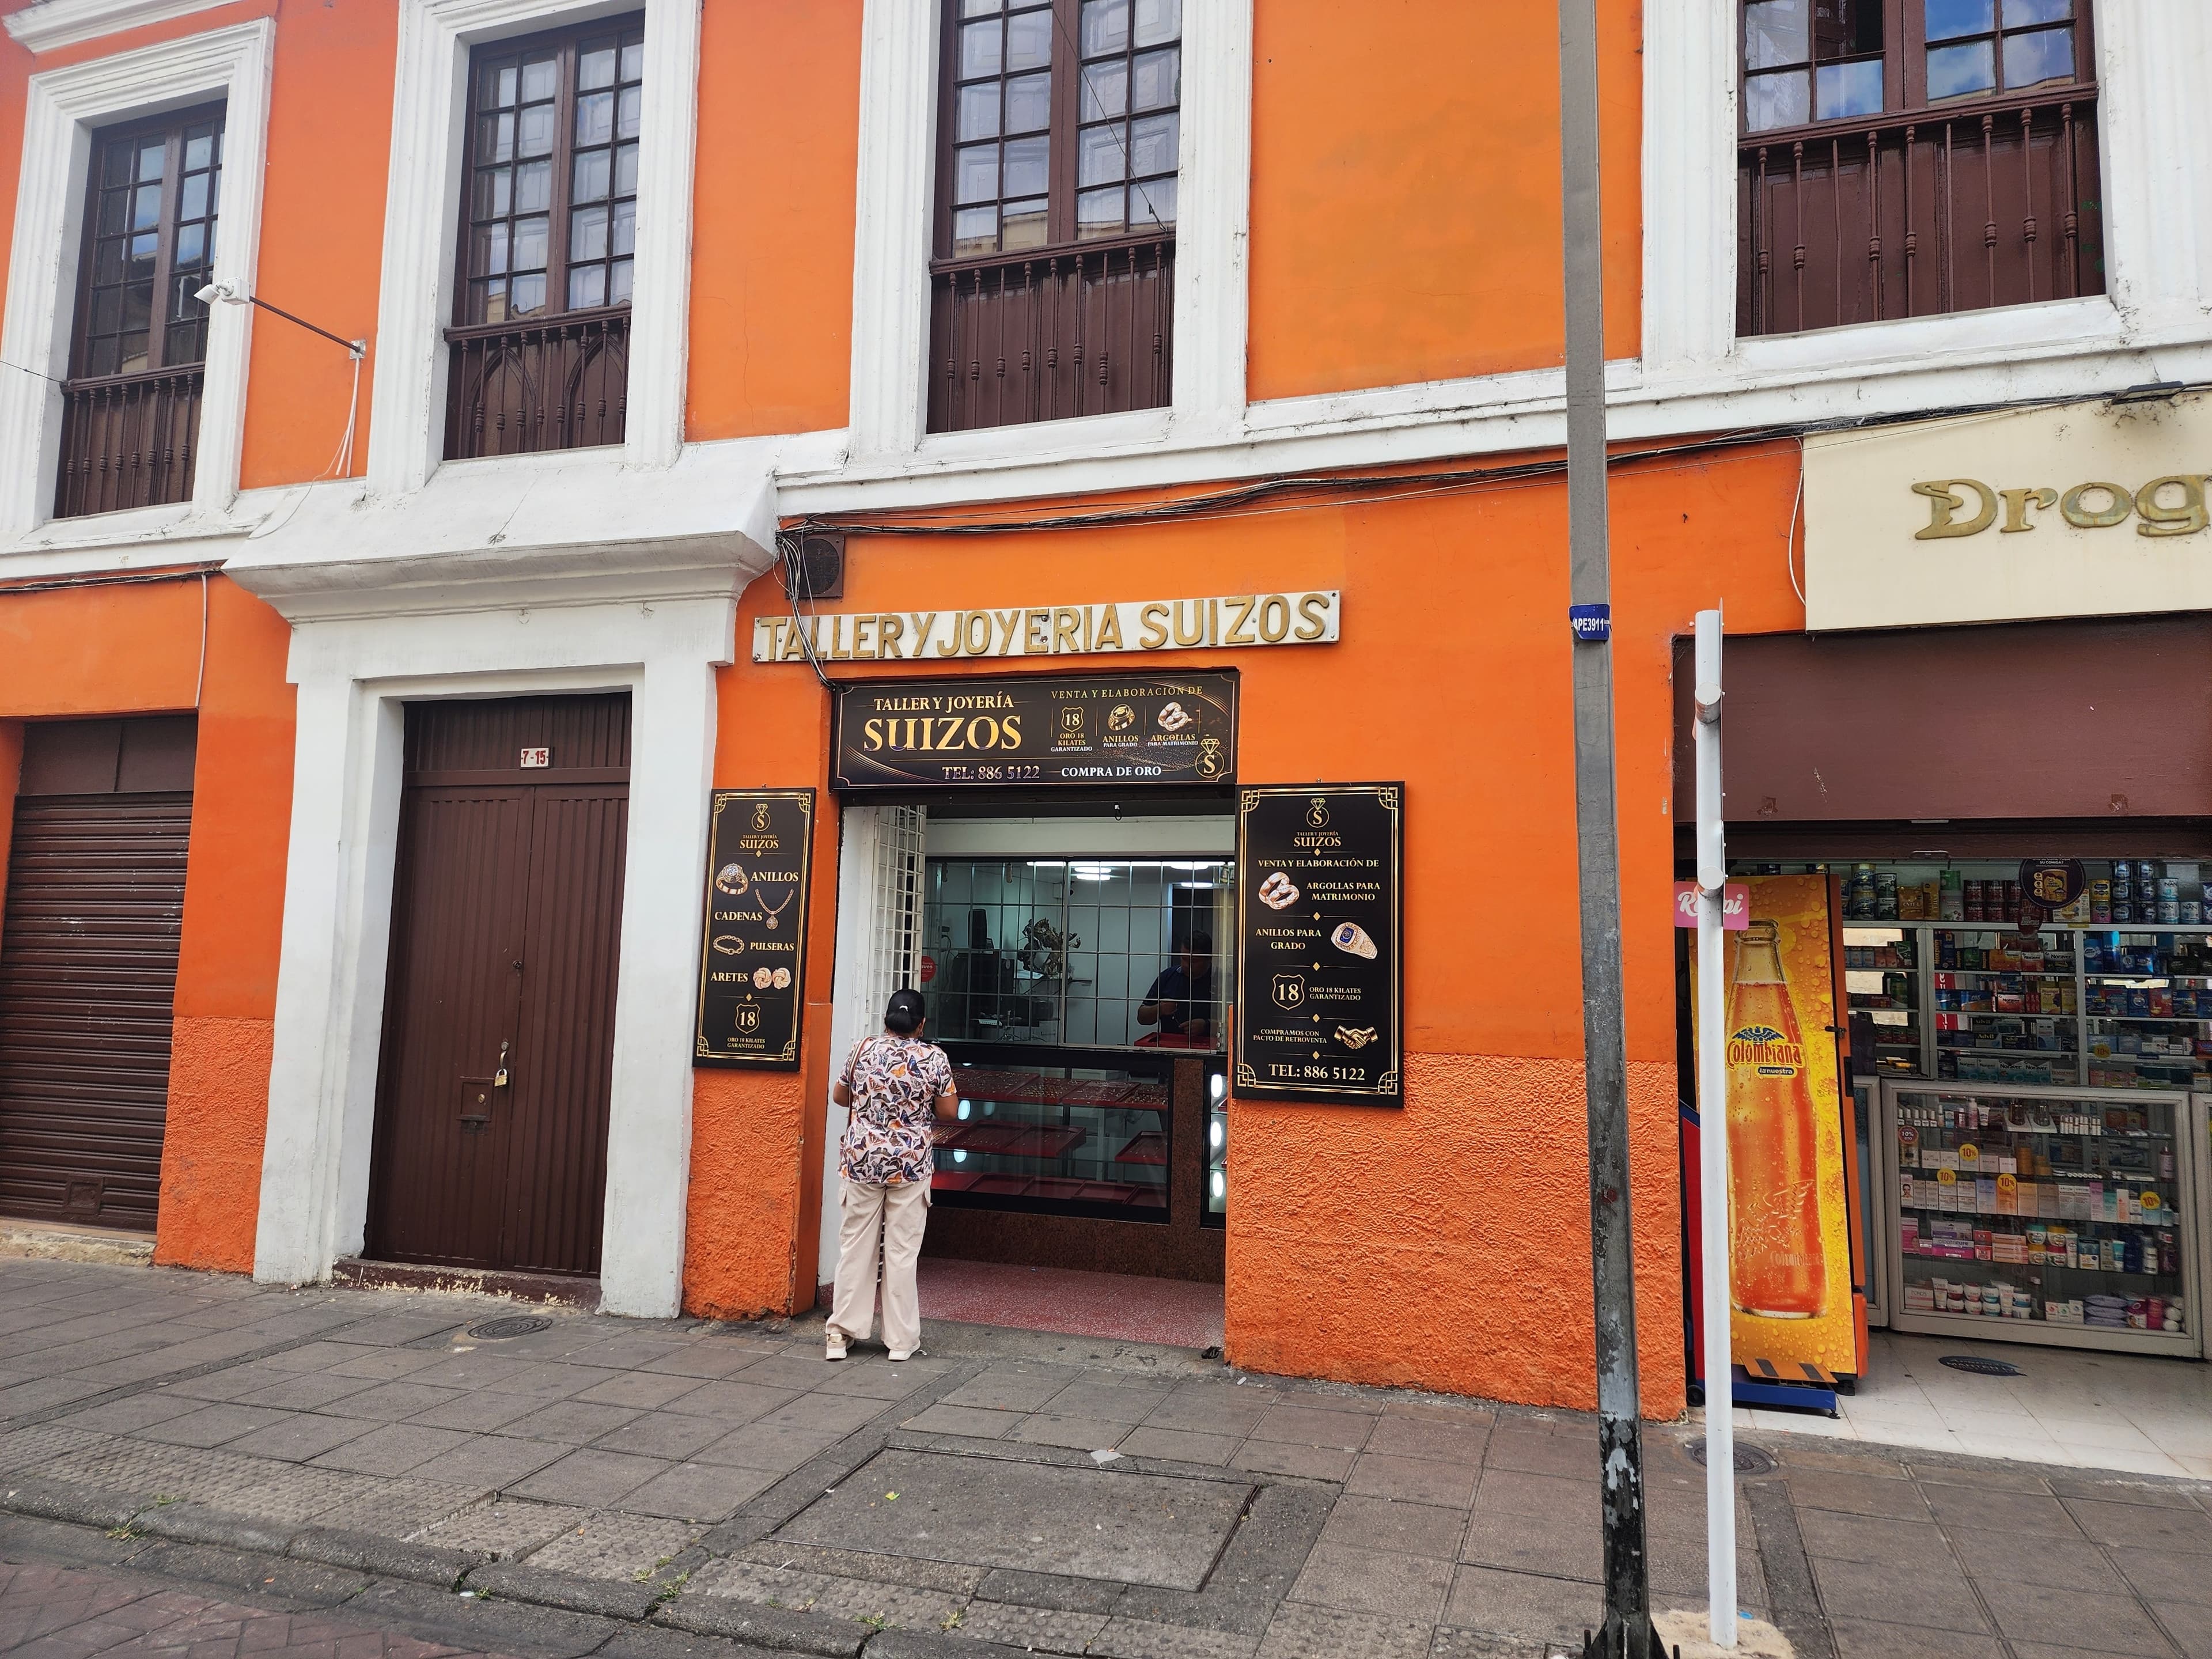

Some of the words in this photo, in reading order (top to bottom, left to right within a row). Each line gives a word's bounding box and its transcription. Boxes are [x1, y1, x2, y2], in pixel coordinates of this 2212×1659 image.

[1911, 474, 2212, 540] Drog
[760, 613, 903, 661] TALLER
[911, 612, 937, 657] Y
[937, 603, 1124, 657] JOYERIA
[1139, 593, 1330, 649] SUIZOS
[1051, 690, 1088, 699] VENTA
[1092, 690, 1099, 698] Y
[1188, 686, 1203, 695] DE
[874, 697, 930, 711] TALLER
[933, 696, 944, 710] Y
[945, 691, 1015, 713] JOYERÍA
[1065, 713, 1080, 726] 18
[863, 715, 1022, 752] SUIZOS
[1103, 734, 1139, 743] ANILLOS
[1150, 733, 1196, 742] ARGOLLAS
[523, 750, 546, 765] 7-15
[1203, 754, 1215, 774] S
[942, 766, 975, 780] TEL:
[978, 766, 1003, 780] 886
[1006, 765, 1040, 779] 5122
[1061, 767, 1115, 777] COMPRA
[1116, 766, 1132, 777] DE
[1135, 766, 1162, 777] ORO
[756, 814, 765, 828] S
[1313, 810, 1323, 825] S
[740, 839, 779, 849] SUIZOS
[1294, 836, 1342, 847] SUIZOS
[1296, 857, 1363, 868] ELABORACIÓN
[750, 872, 799, 882] ANILLOS
[1306, 882, 1354, 890] ARGOLLAS
[1311, 893, 1376, 901] MATRIMONIO
[1678, 891, 1743, 917] Rpi
[714, 911, 763, 922] CADENAS
[1255, 929, 1294, 937] ANILLOS
[1296, 929, 1321, 937] PARA
[750, 942, 795, 951] PULSERAS
[1271, 942, 1306, 950] GRADO
[710, 972, 749, 982] ARETES
[1278, 983, 1300, 1001] 18
[1309, 993, 1361, 1001] GARANTIZADO
[740, 1011, 756, 1027] 18
[1727, 1040, 1802, 1067] Colombiana
[1268, 1063, 1301, 1078] TEL:
[1304, 1065, 1328, 1079] 886
[1333, 1067, 1365, 1081] 5122
